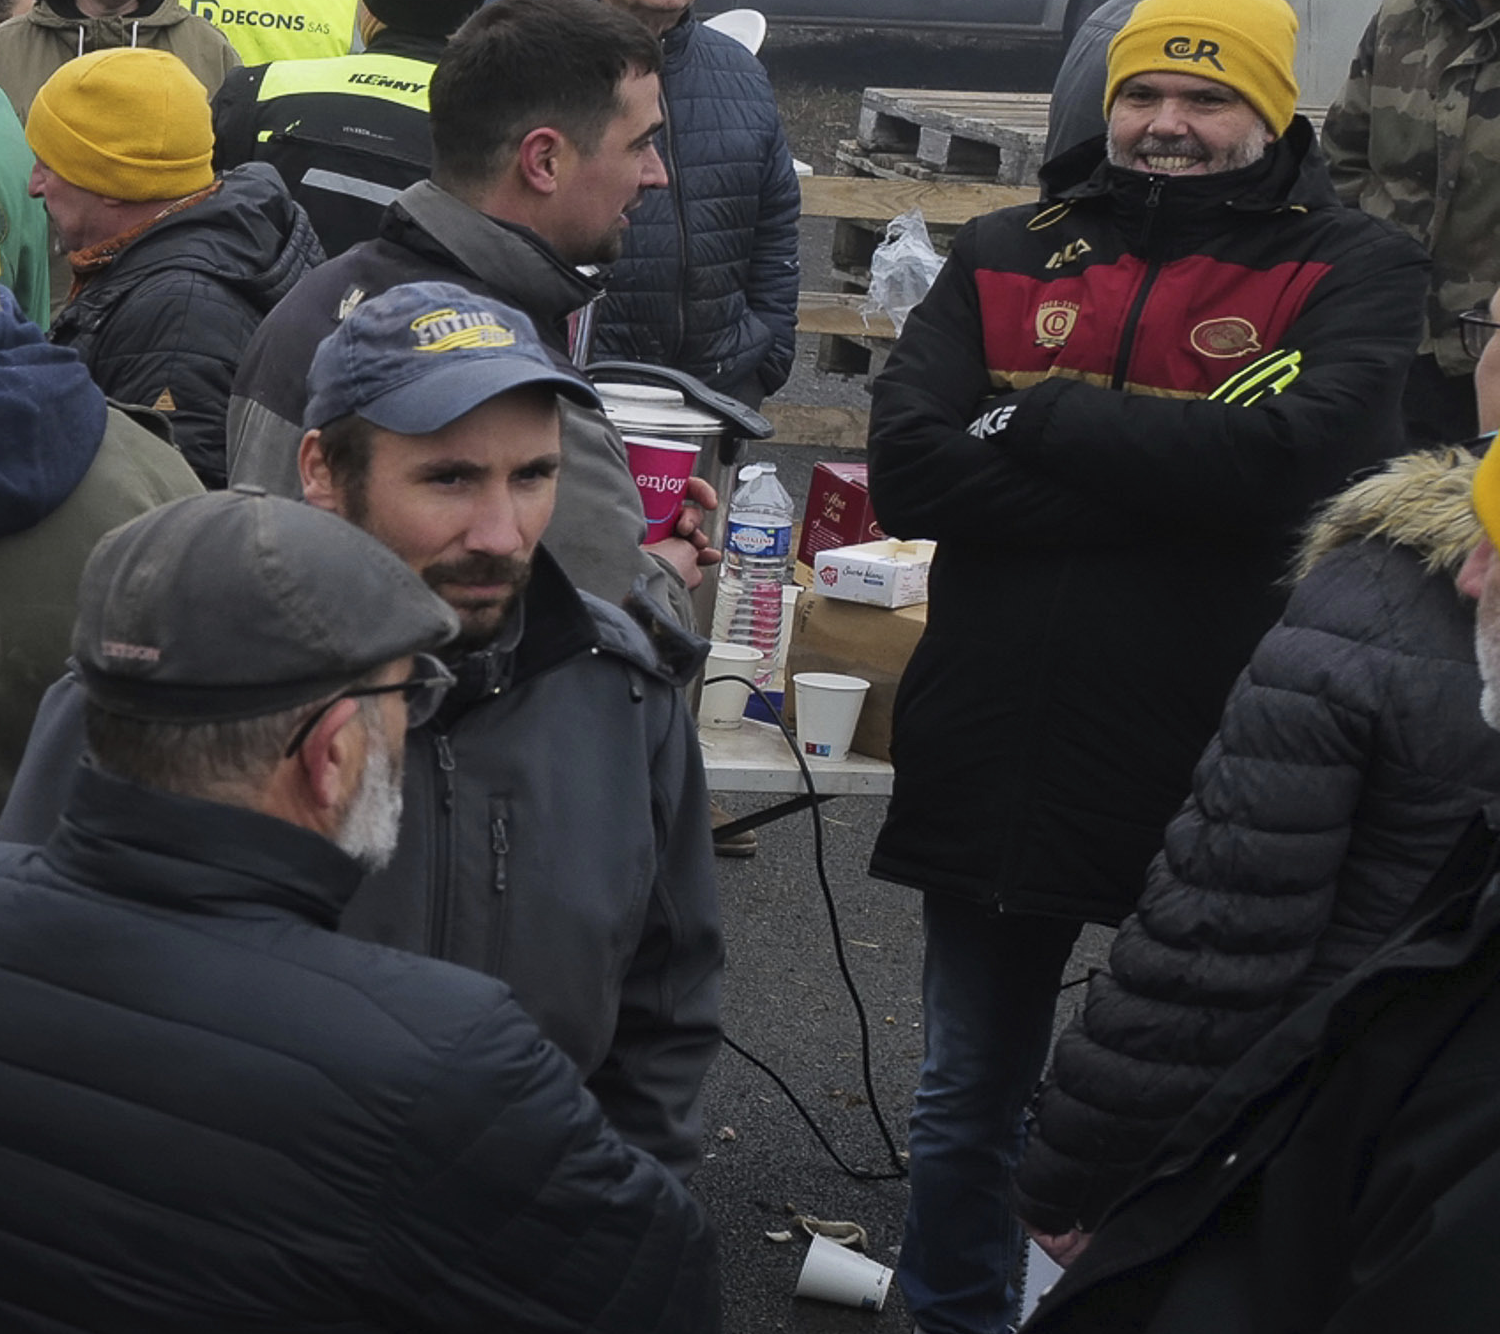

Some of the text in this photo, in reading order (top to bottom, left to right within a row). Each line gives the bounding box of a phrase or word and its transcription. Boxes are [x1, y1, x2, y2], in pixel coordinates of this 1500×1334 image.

[221, 9, 330, 35] DECONS SAS
[348, 73, 426, 94] KENNY
[636, 474, 687, 493] enjoy
